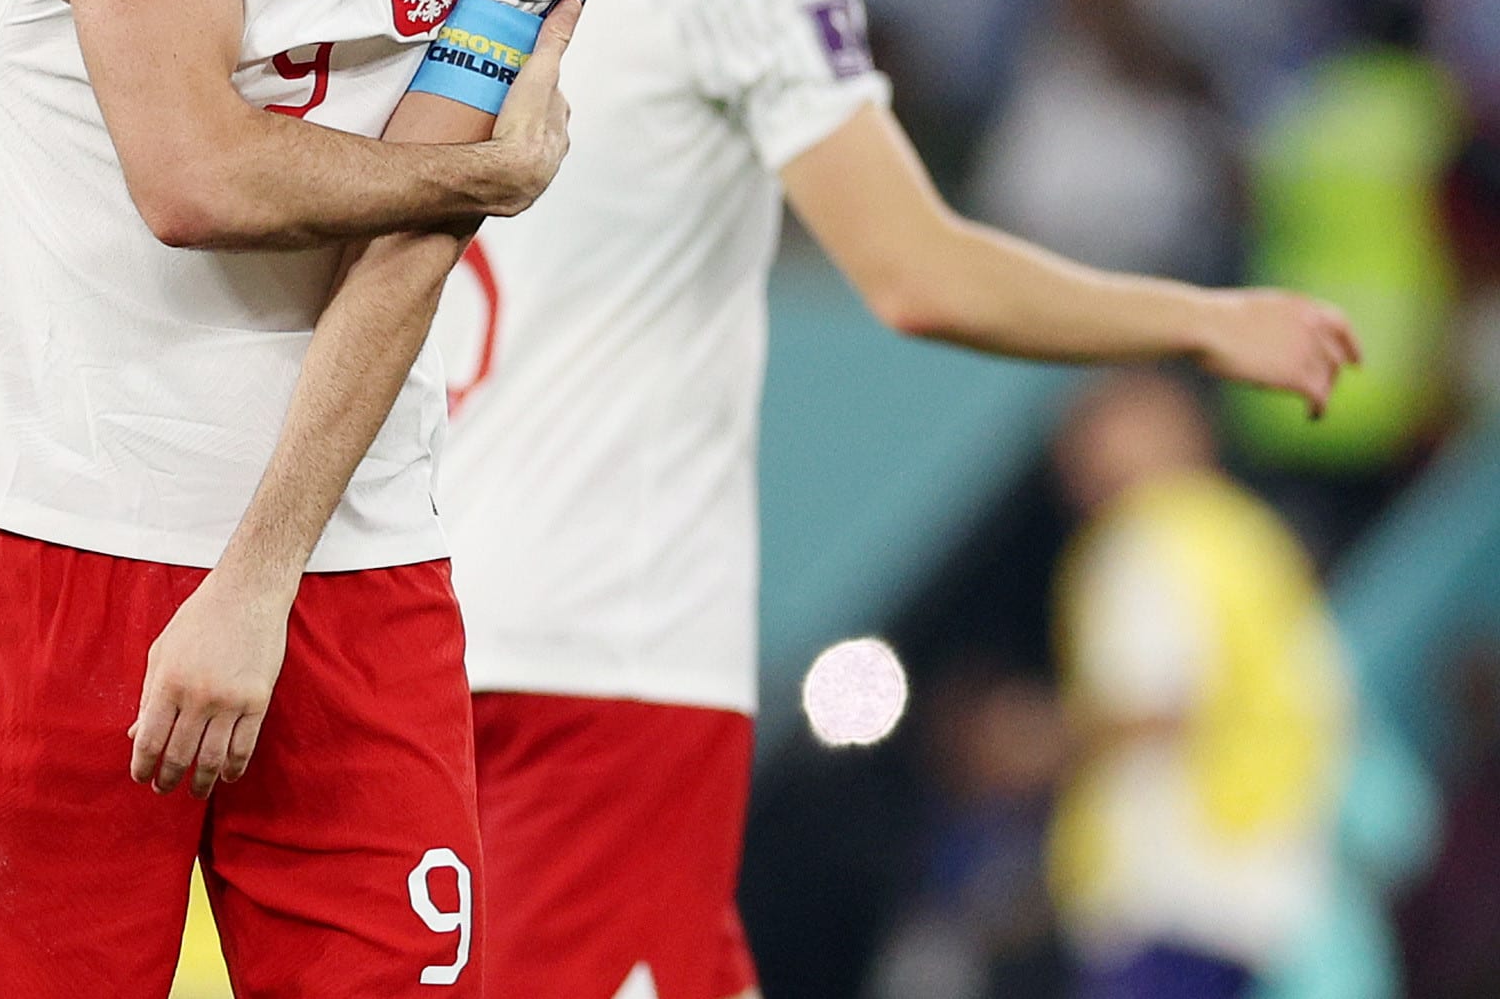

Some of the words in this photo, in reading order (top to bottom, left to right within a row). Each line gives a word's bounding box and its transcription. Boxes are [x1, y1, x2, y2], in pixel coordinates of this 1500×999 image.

[427, 46, 520, 86] CHILDR
[438, 26, 532, 67] PROTE
[407, 847, 472, 985] 9
